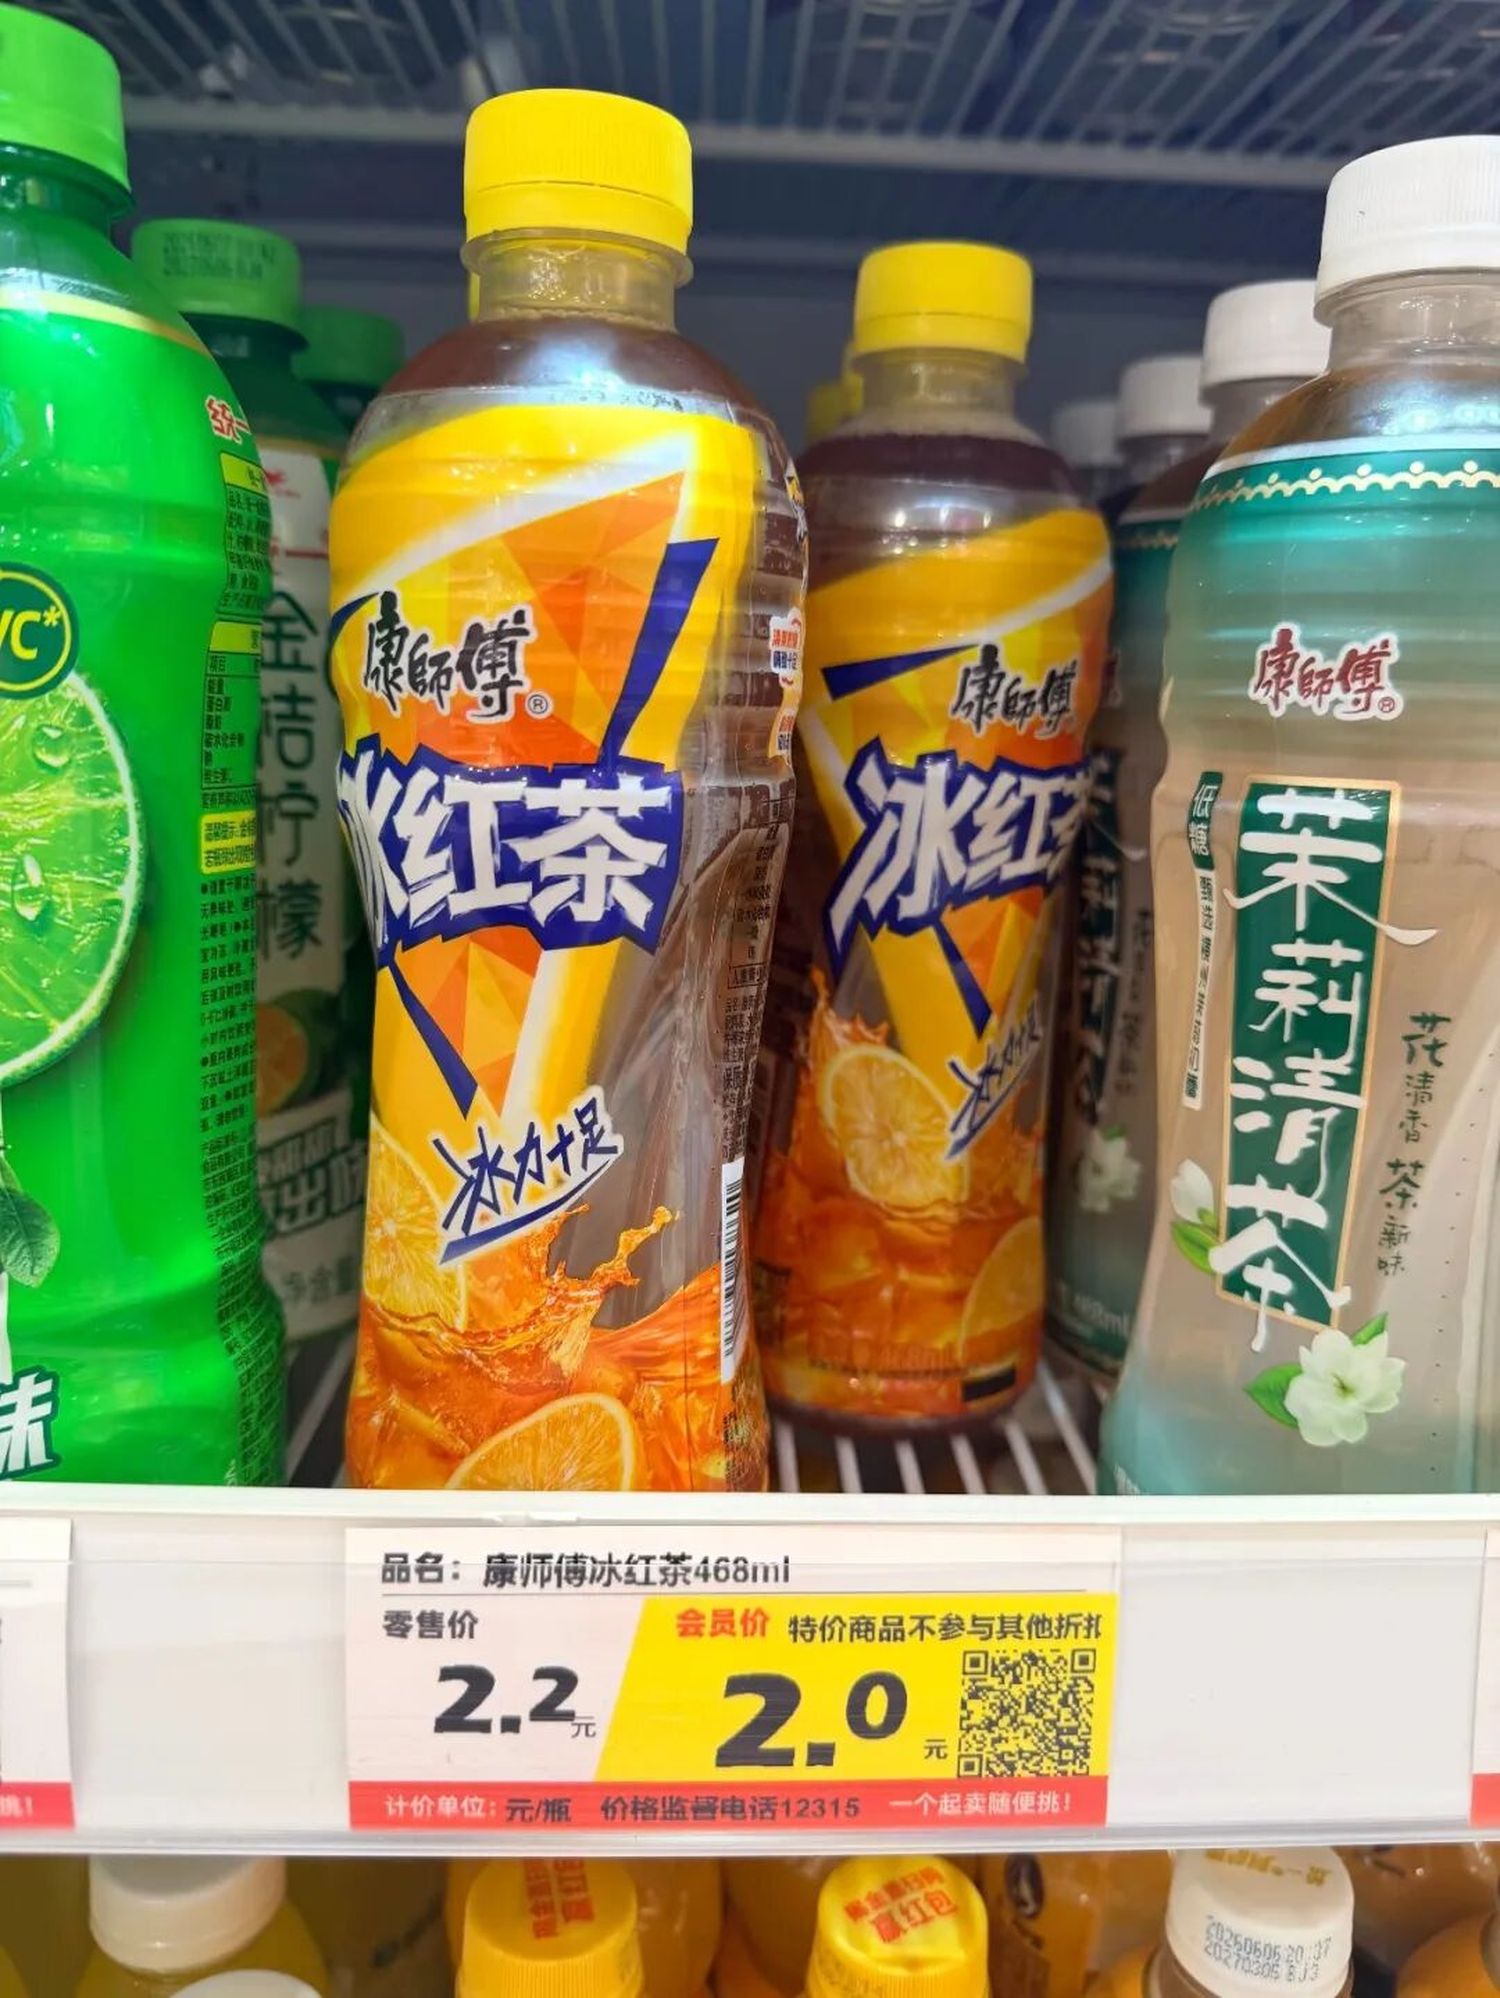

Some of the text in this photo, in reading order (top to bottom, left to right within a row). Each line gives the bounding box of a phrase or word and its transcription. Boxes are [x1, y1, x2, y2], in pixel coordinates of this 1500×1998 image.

[363, 590, 532, 721] 康師傅
[950, 644, 1078, 736] 康師傅
[1253, 627, 1392, 715] 康師傅
[1209, 787, 1439, 1353] 茉莉清茶
[432, 1096, 619, 1238] 冰力十足
[381, 1551, 790, 1589] 品名： 康师傅冰红茶468ml
[381, 1609, 479, 1641] 零售价
[675, 1607, 771, 1638] 会员价
[433, 1664, 597, 1739] 2.2 元
[714, 1669, 949, 1768] 2.0 元
[505, 1796, 573, 1824] 元/瓶
[600, 1794, 861, 1822] 价格监督电话12315
